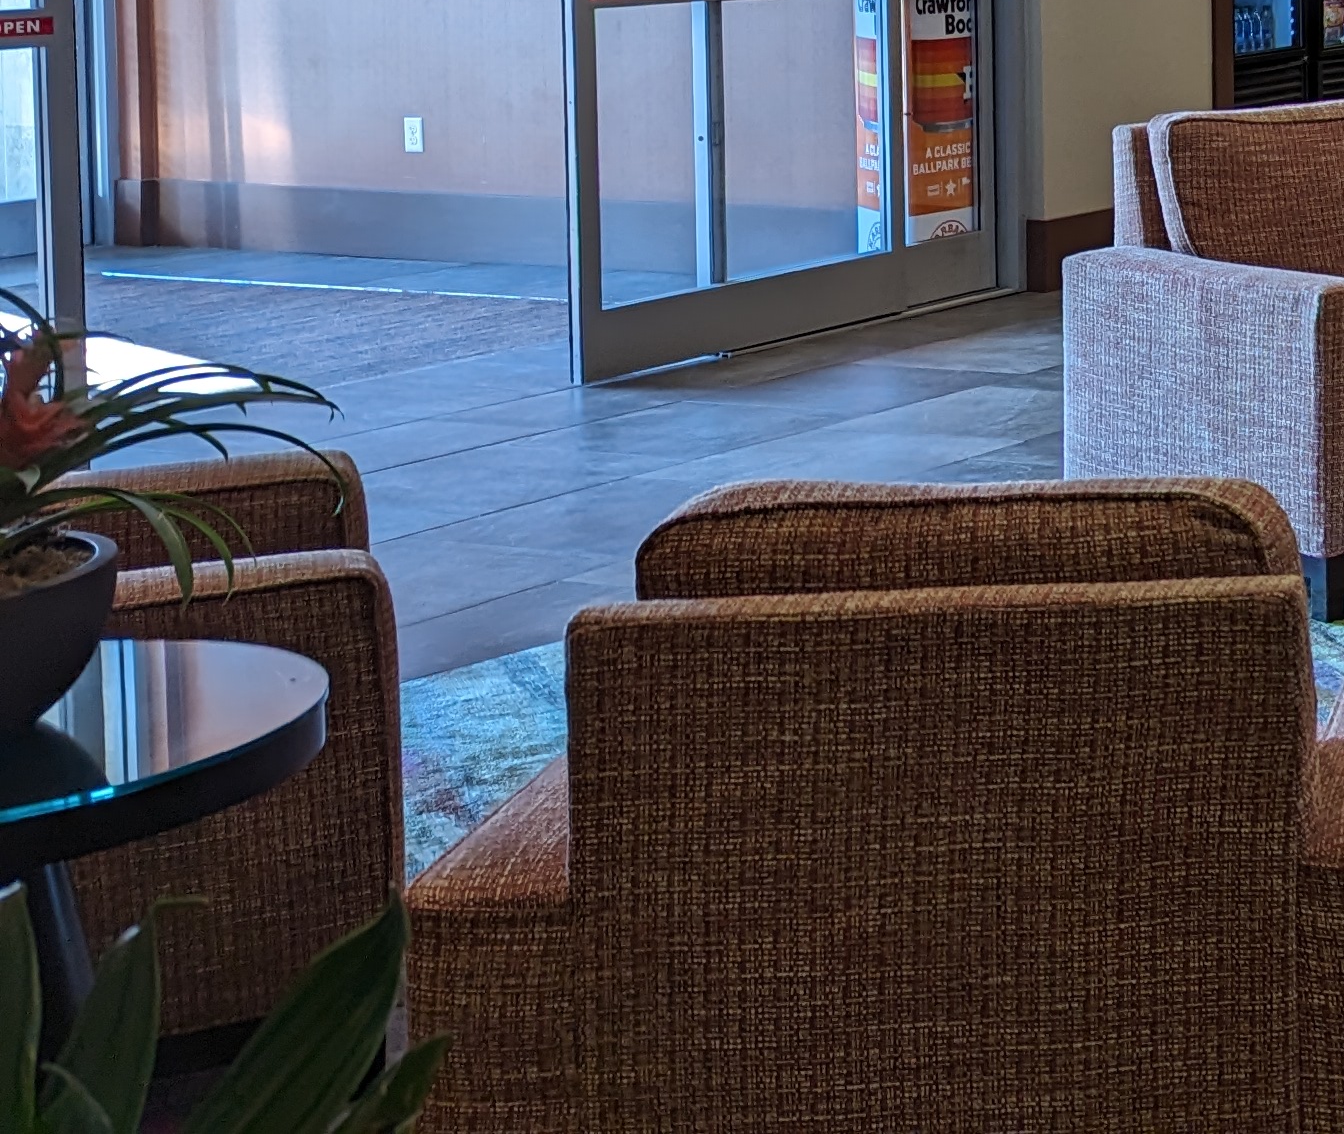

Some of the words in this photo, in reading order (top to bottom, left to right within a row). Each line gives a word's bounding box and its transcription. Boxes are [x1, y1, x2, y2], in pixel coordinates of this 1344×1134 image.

[0, 19, 41, 35] PEN
[925, 147, 933, 159] A
[934, 142, 971, 157] CLASSIC
[912, 160, 960, 175] BALLPARK
